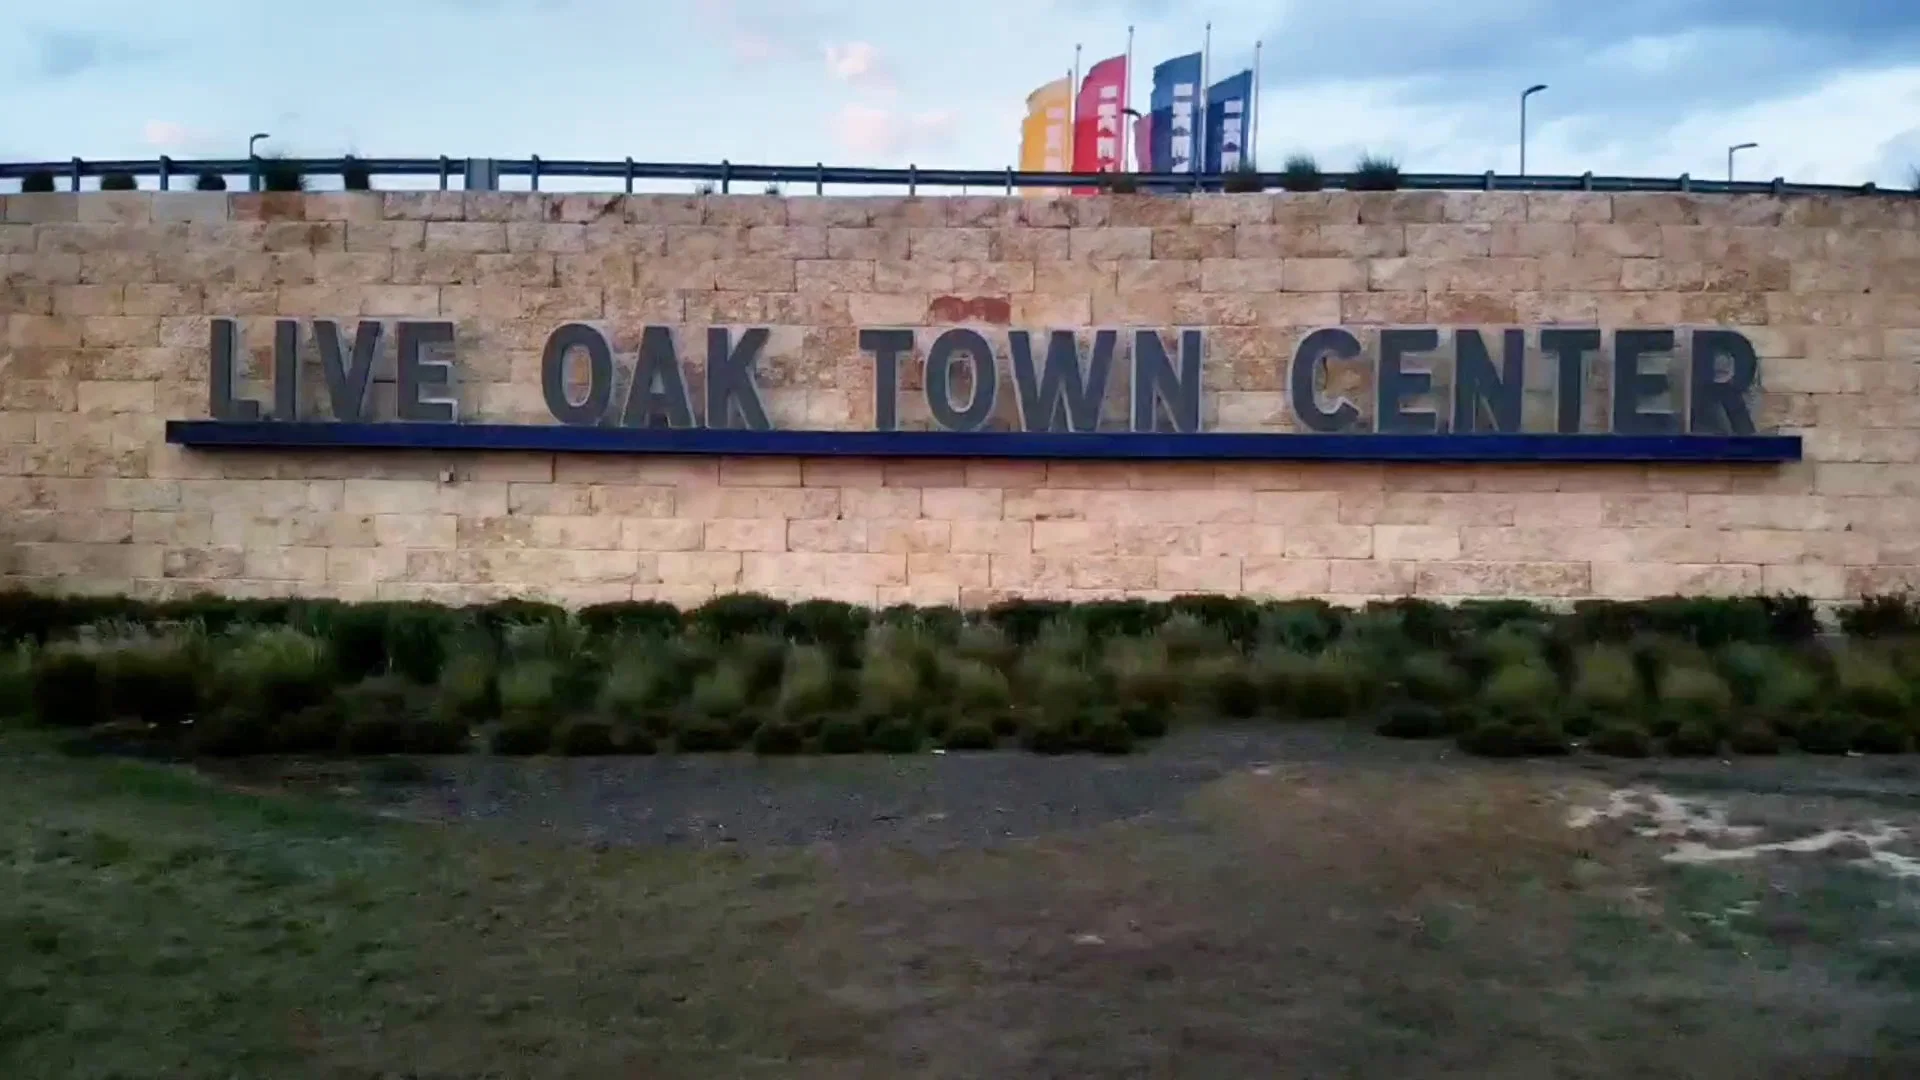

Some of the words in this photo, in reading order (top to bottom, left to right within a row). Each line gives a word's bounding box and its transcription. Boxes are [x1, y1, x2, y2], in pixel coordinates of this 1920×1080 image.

[208, 318, 457, 422] LIVE
[541, 322, 772, 430] OAK
[858, 327, 1202, 433] TOWN
[1290, 327, 1758, 434] CENTER
